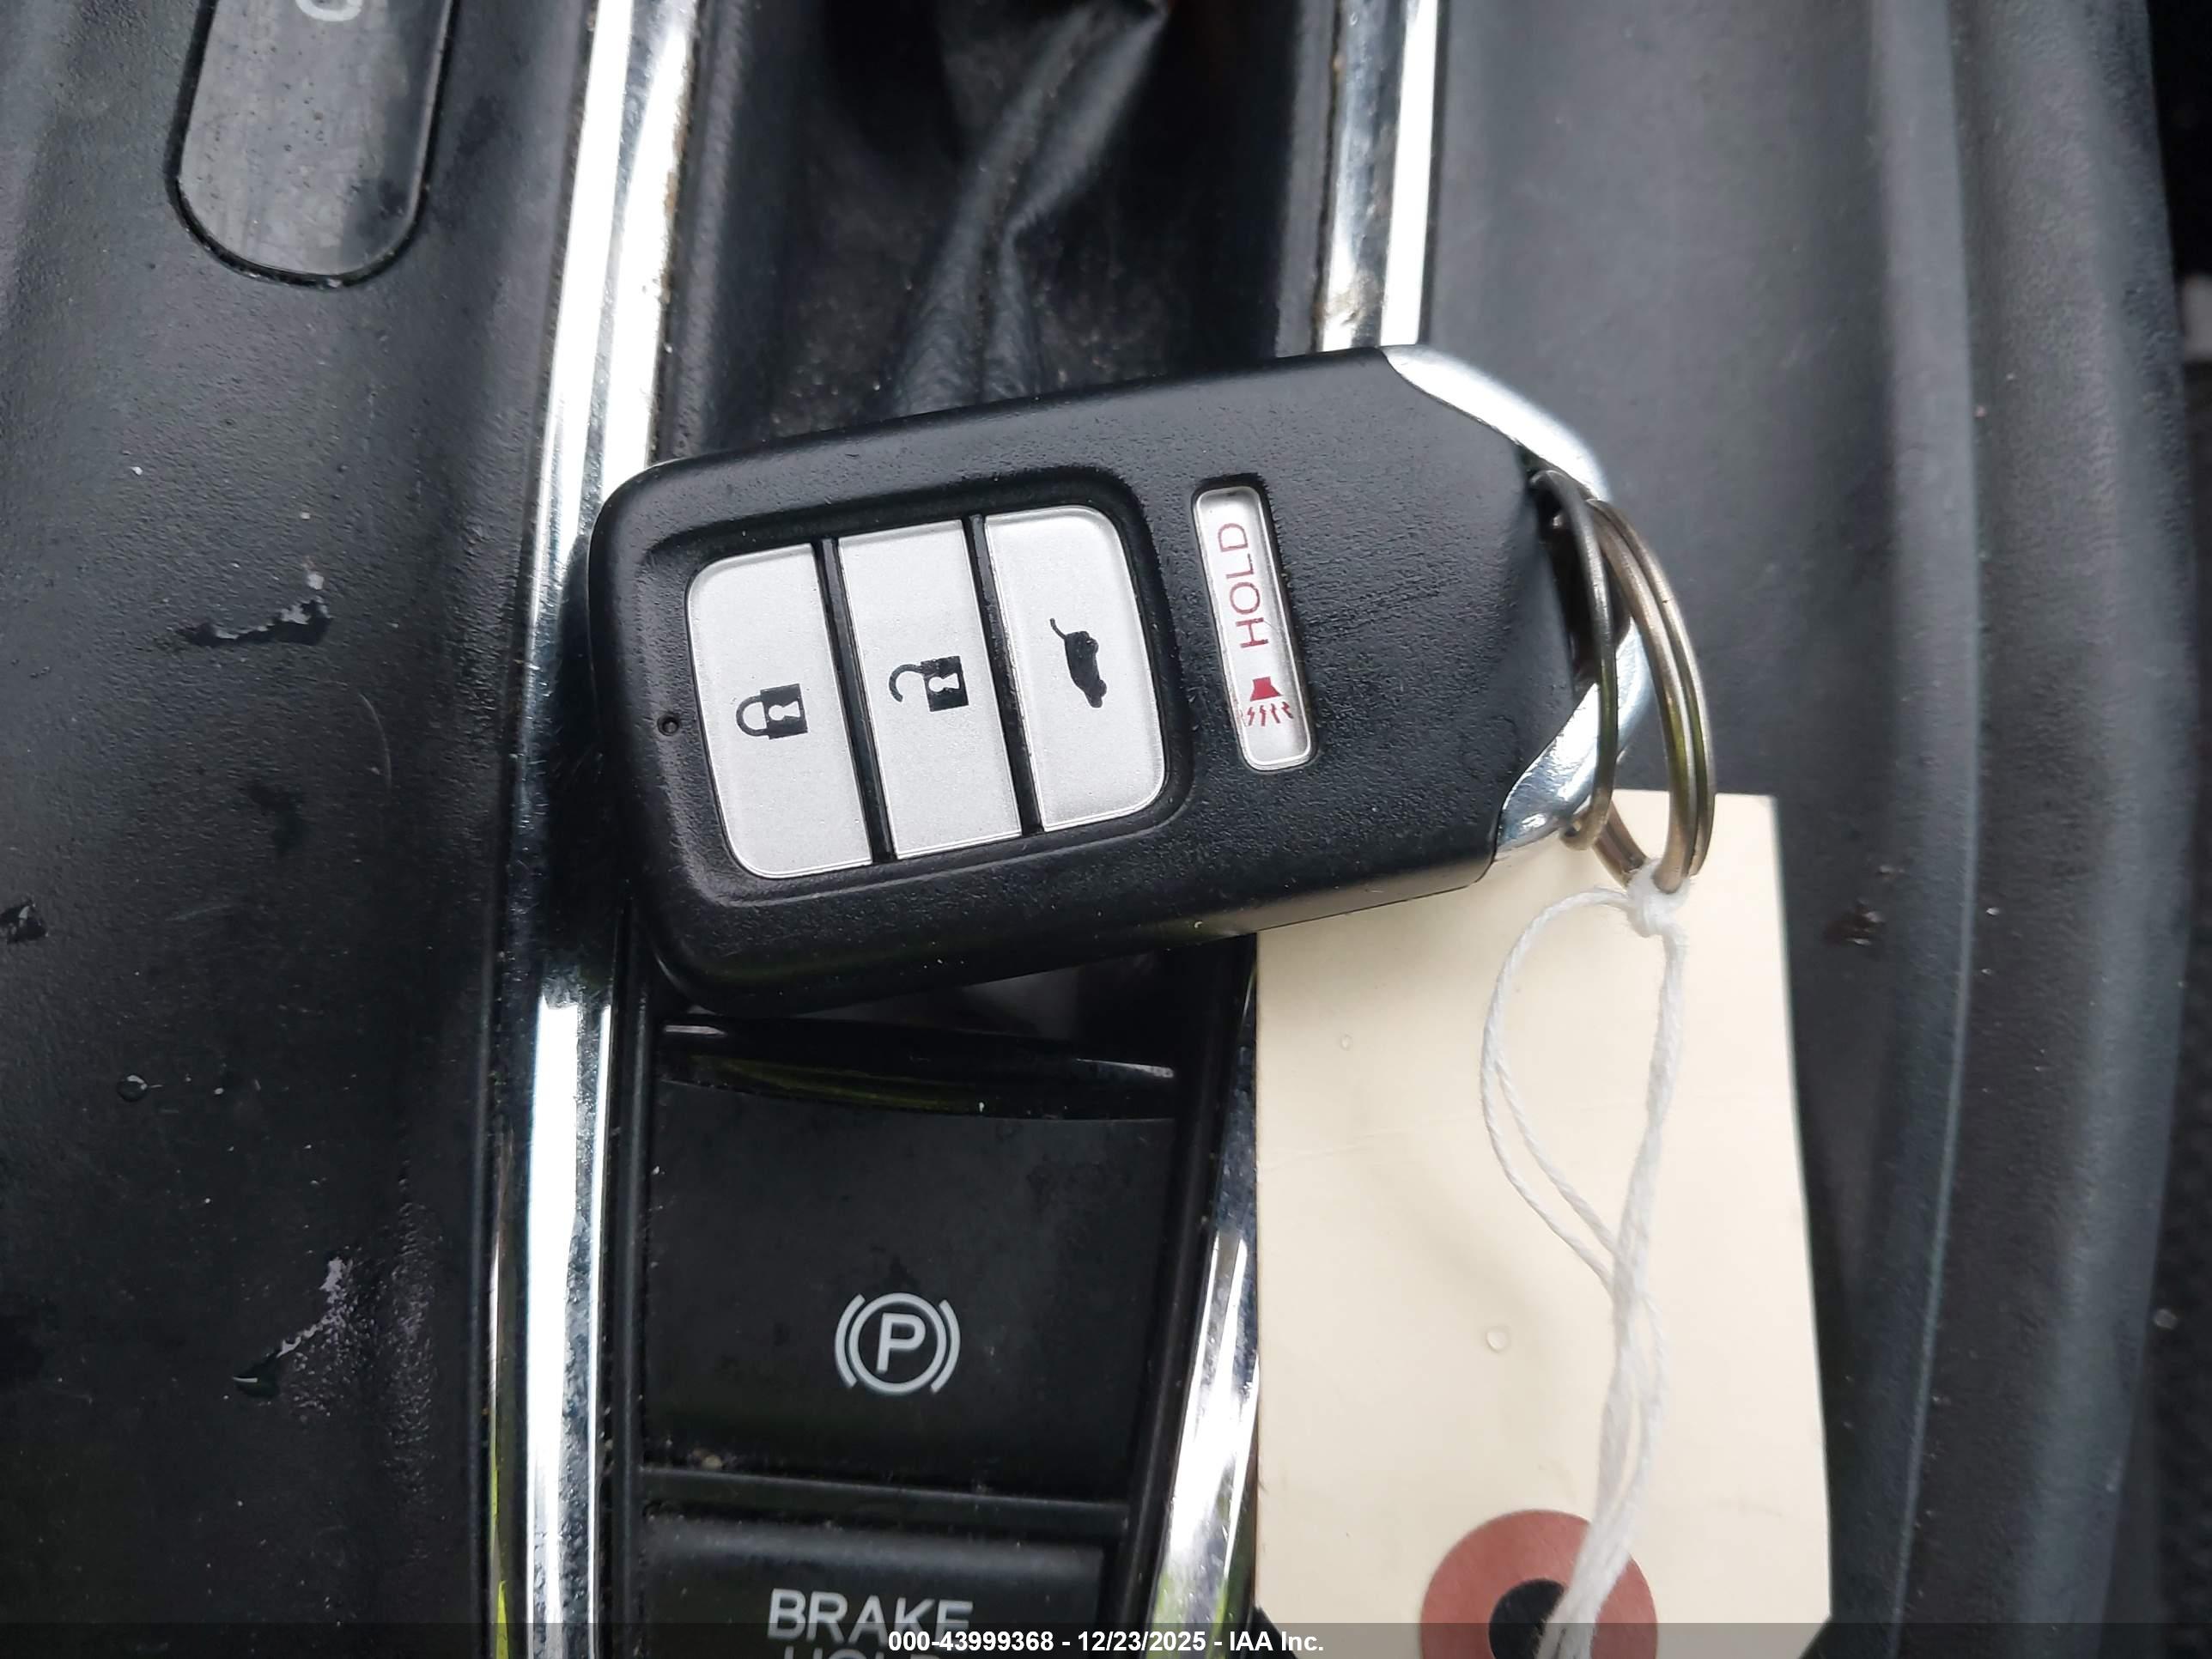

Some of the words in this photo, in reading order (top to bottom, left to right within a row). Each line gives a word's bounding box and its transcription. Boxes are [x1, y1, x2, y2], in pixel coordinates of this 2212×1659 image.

[1217, 522, 1270, 649] HOLD
[875, 1311, 927, 1374] P
[767, 1588, 974, 1649] BRAKE
